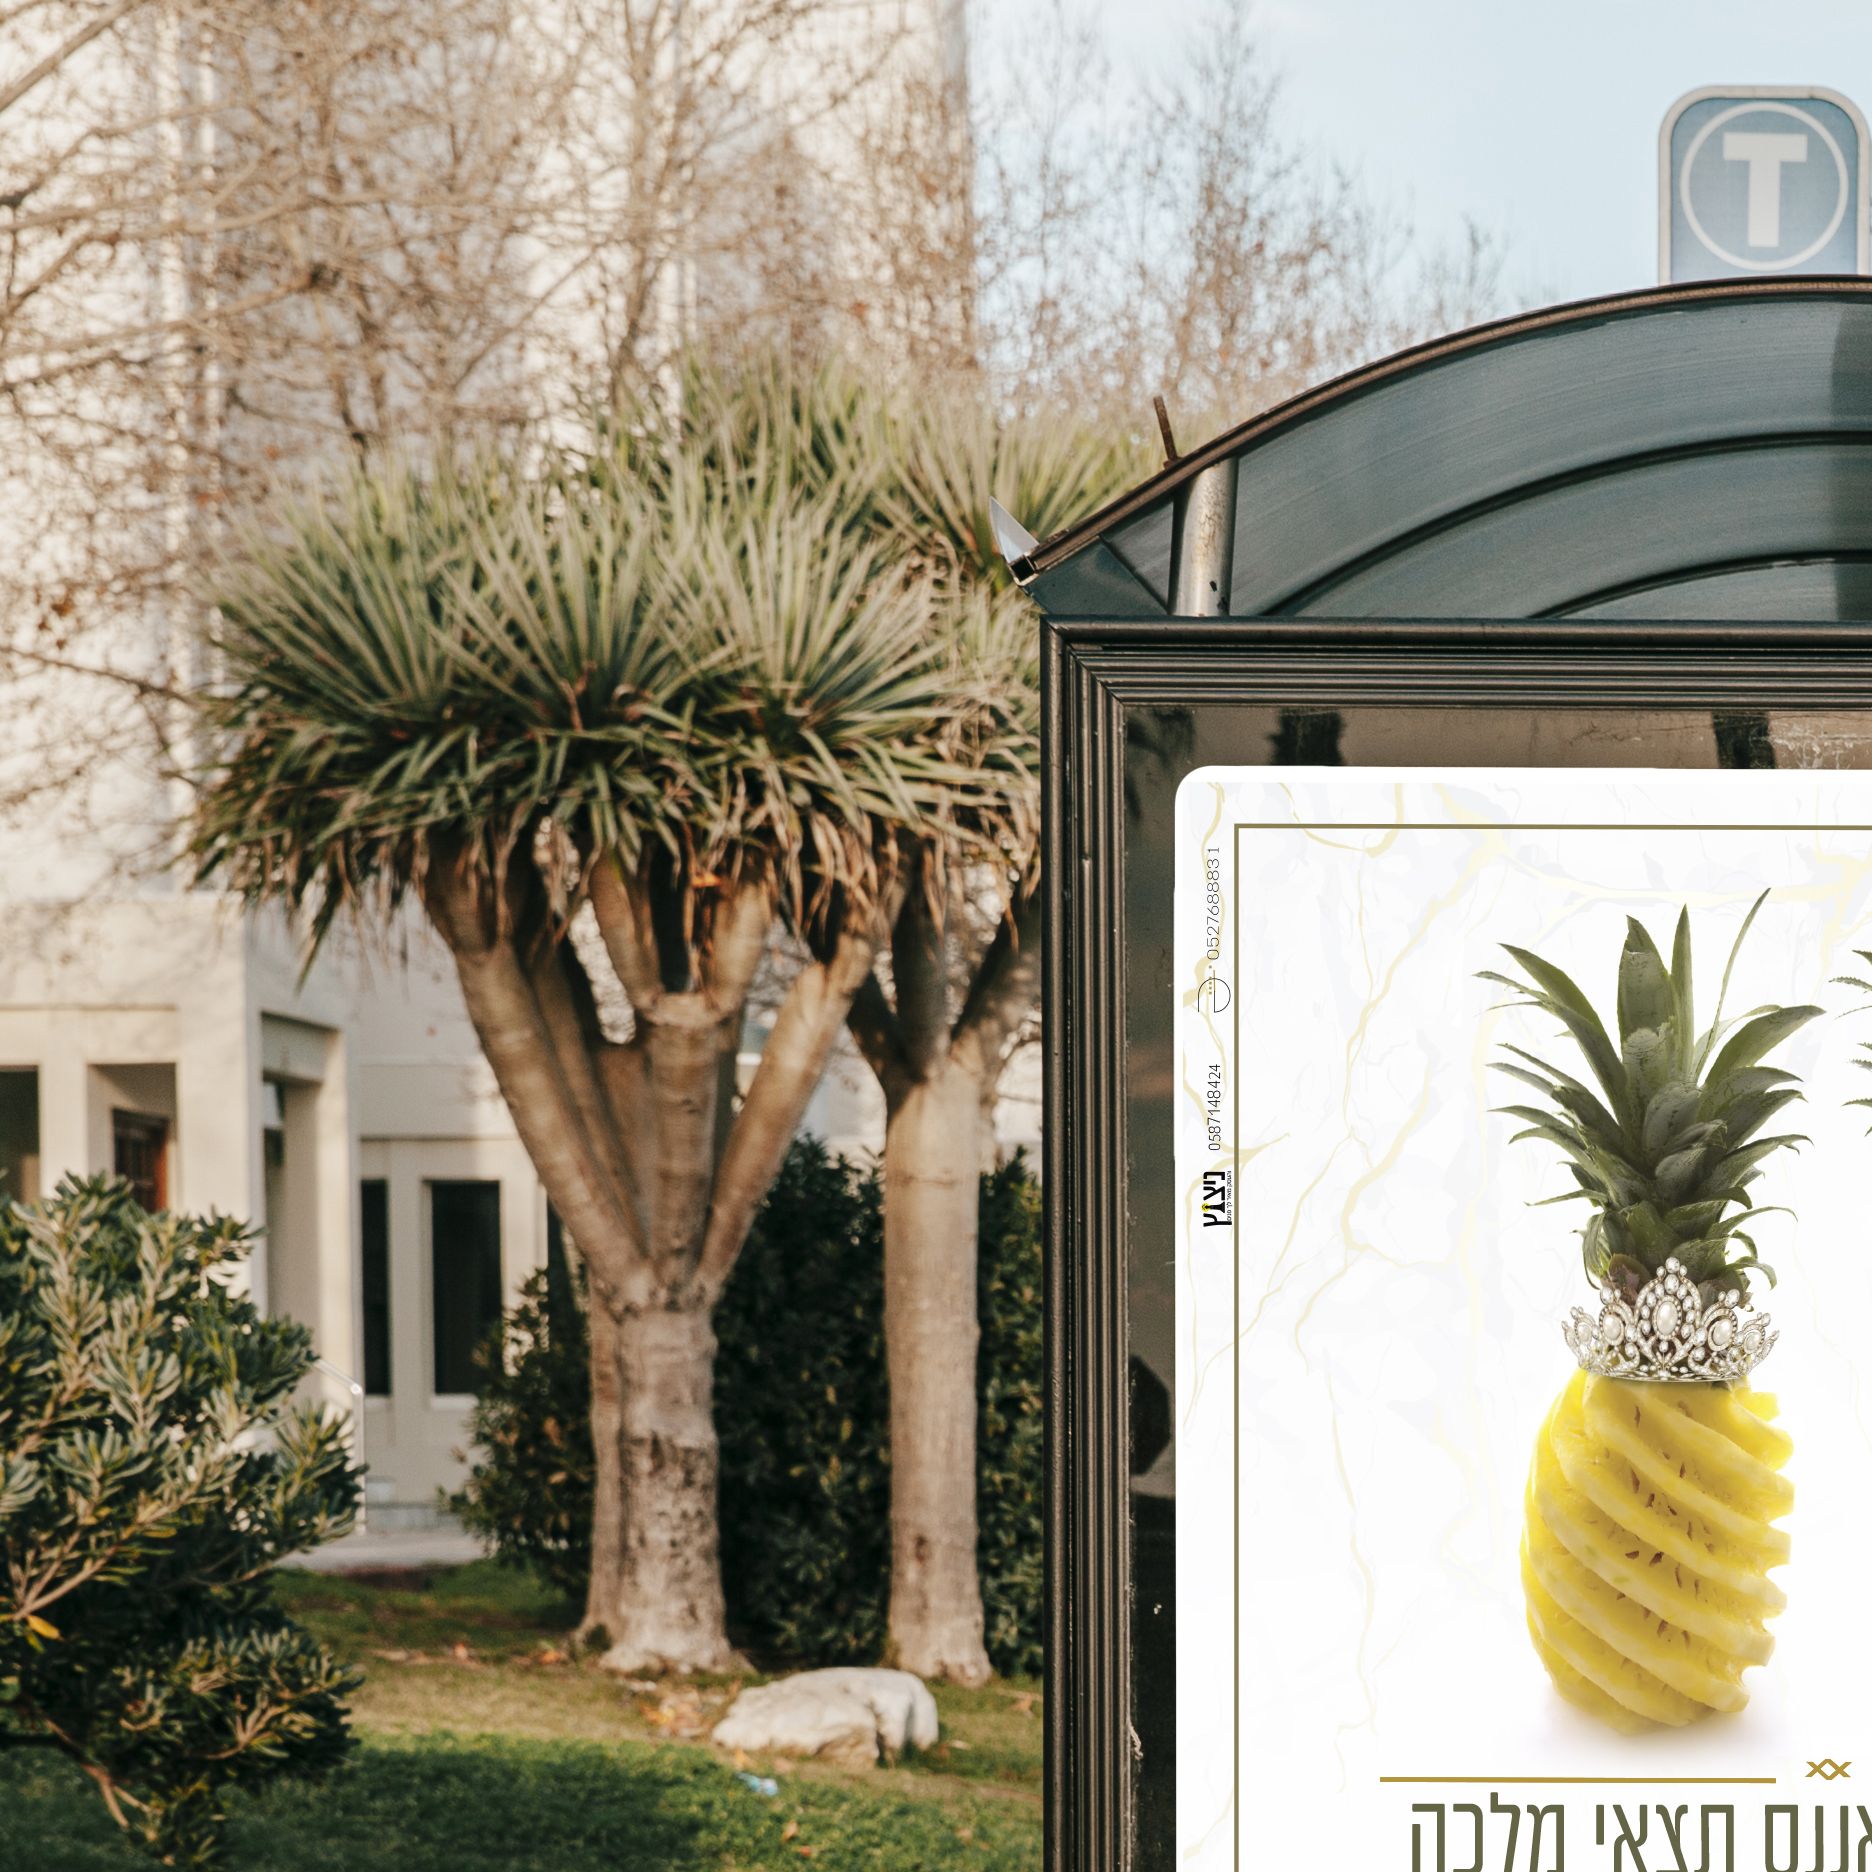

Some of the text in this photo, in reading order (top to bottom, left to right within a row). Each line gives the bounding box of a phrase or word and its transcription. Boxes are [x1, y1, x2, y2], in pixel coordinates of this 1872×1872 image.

[1723, 131, 1807, 248] T
[1206, 846, 1221, 961] 0527688831
[1206, 1063, 1222, 1152] 0587148424
